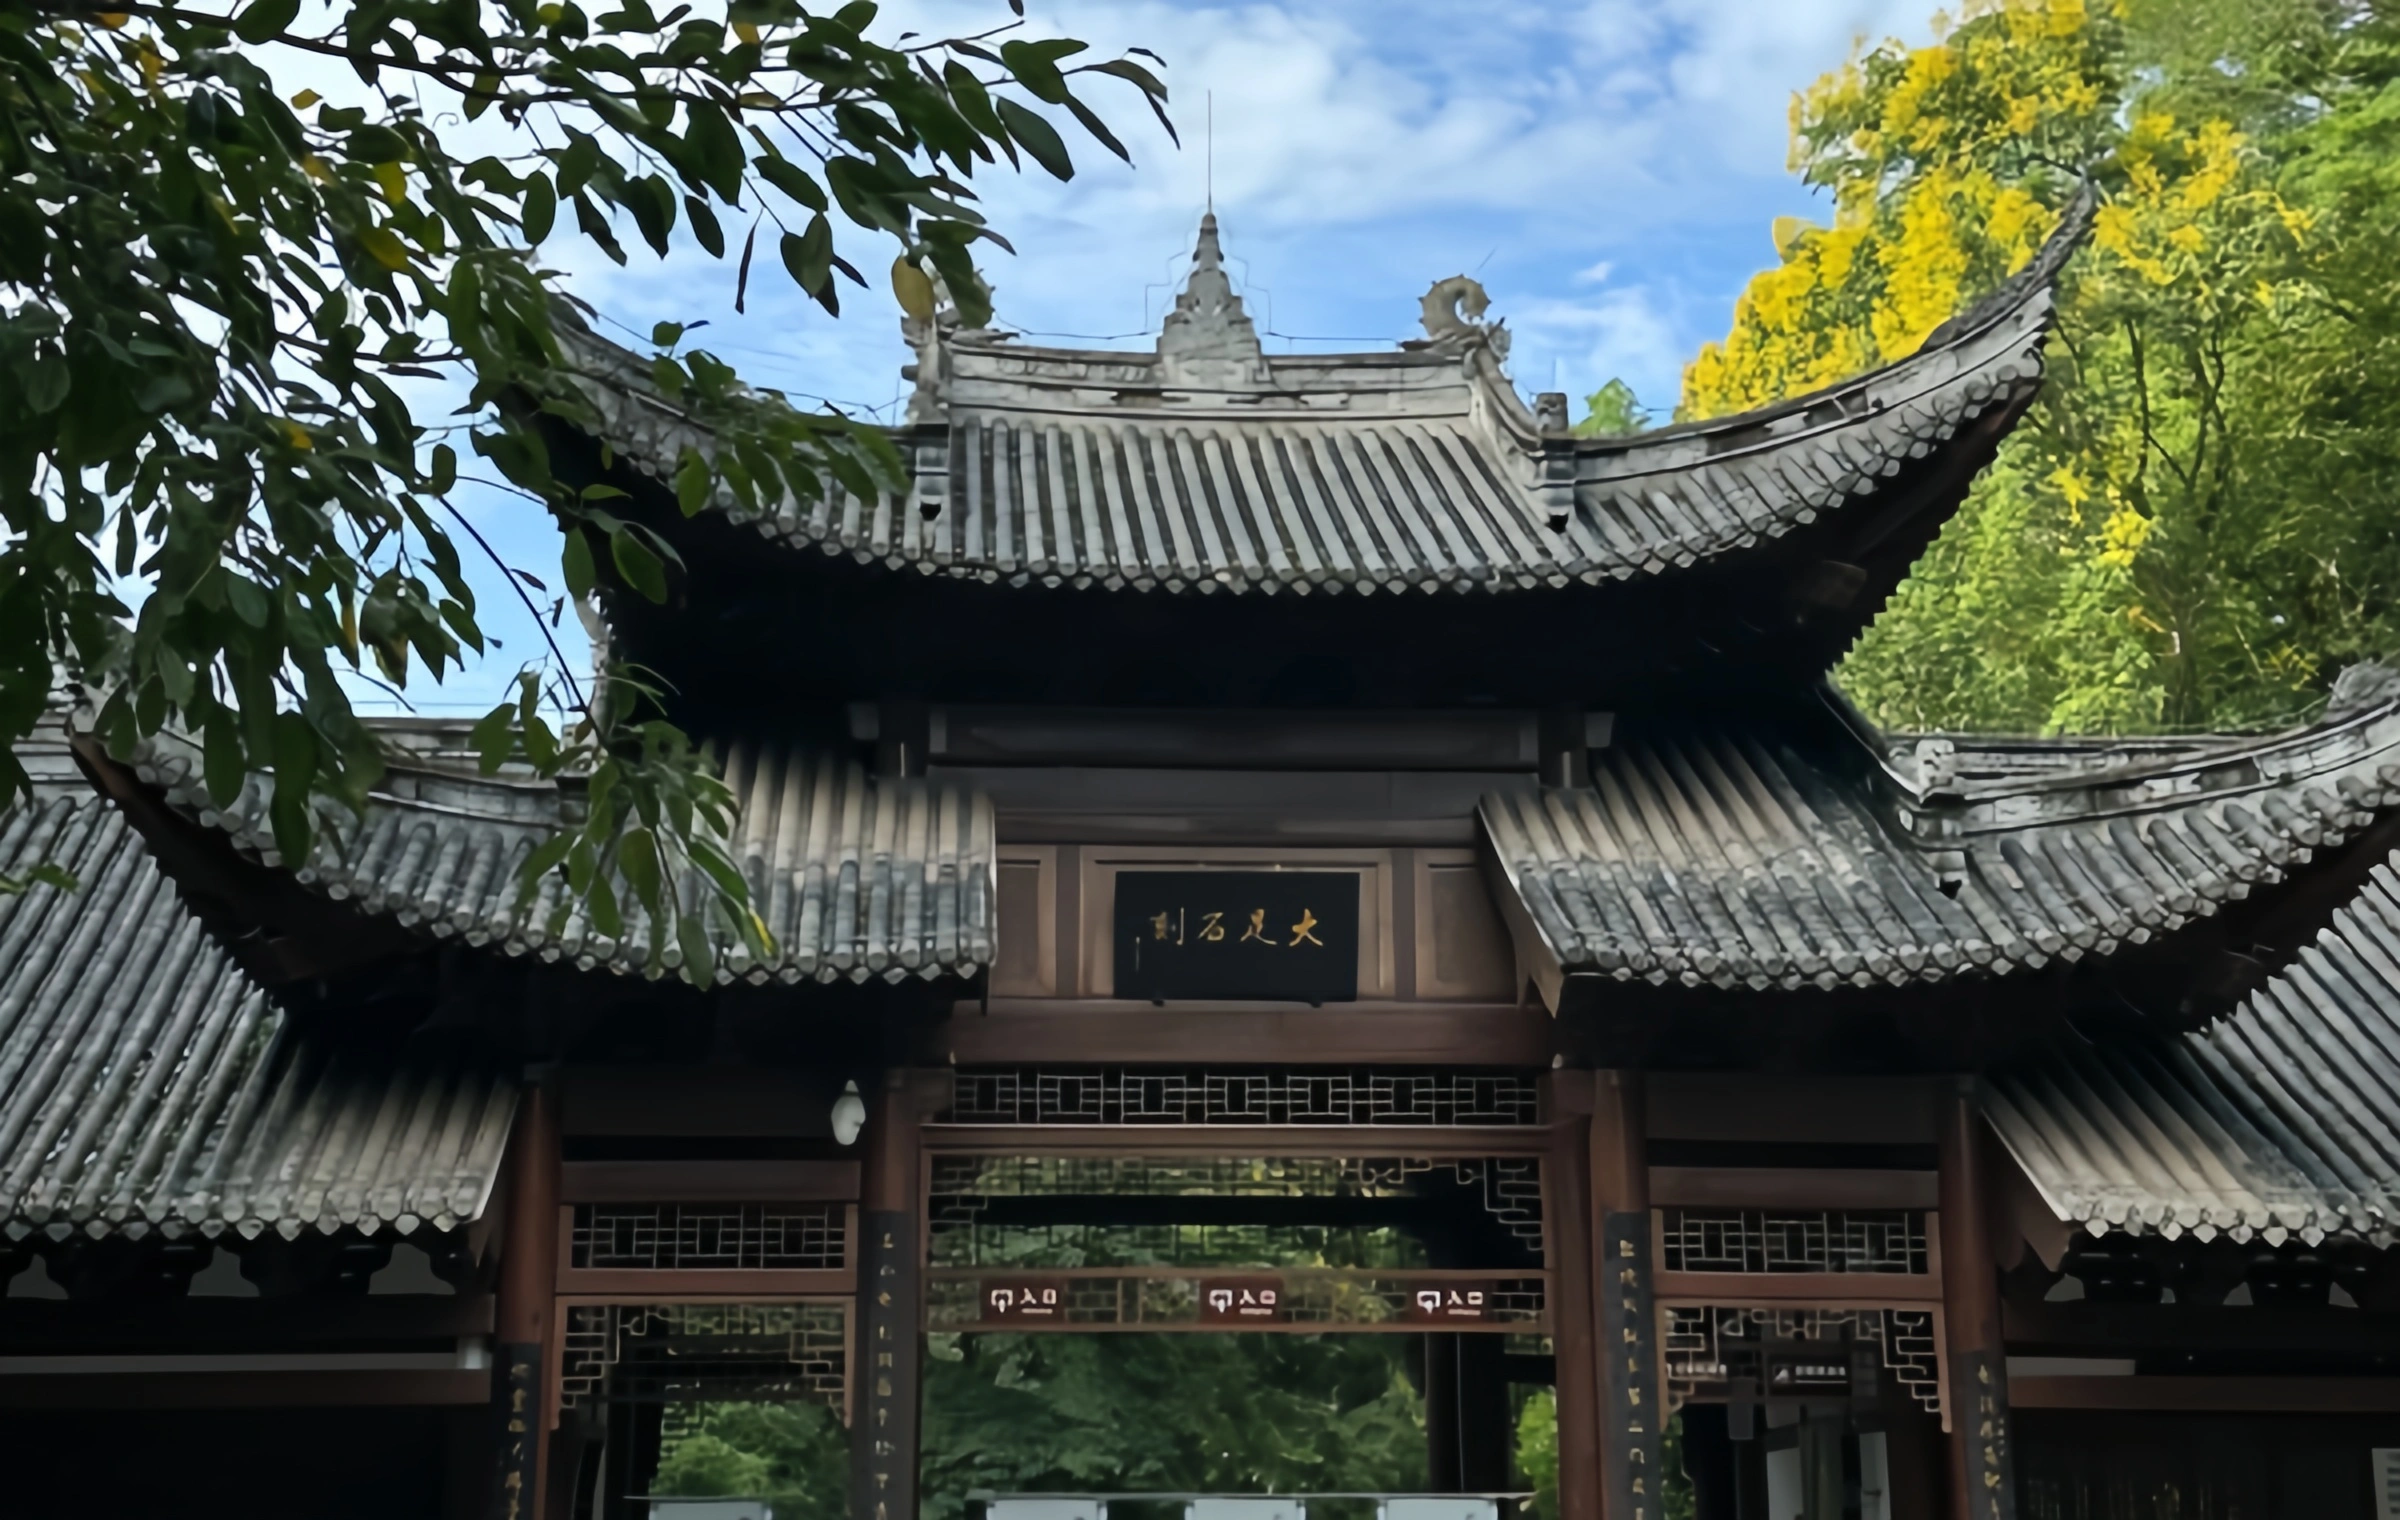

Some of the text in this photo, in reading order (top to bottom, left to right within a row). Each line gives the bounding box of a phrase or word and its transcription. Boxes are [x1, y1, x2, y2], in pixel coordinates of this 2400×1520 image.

[1020, 1287, 1057, 1305] 入口
[1239, 1288, 1276, 1305] 入口
[1447, 1290, 1483, 1305] 入口
